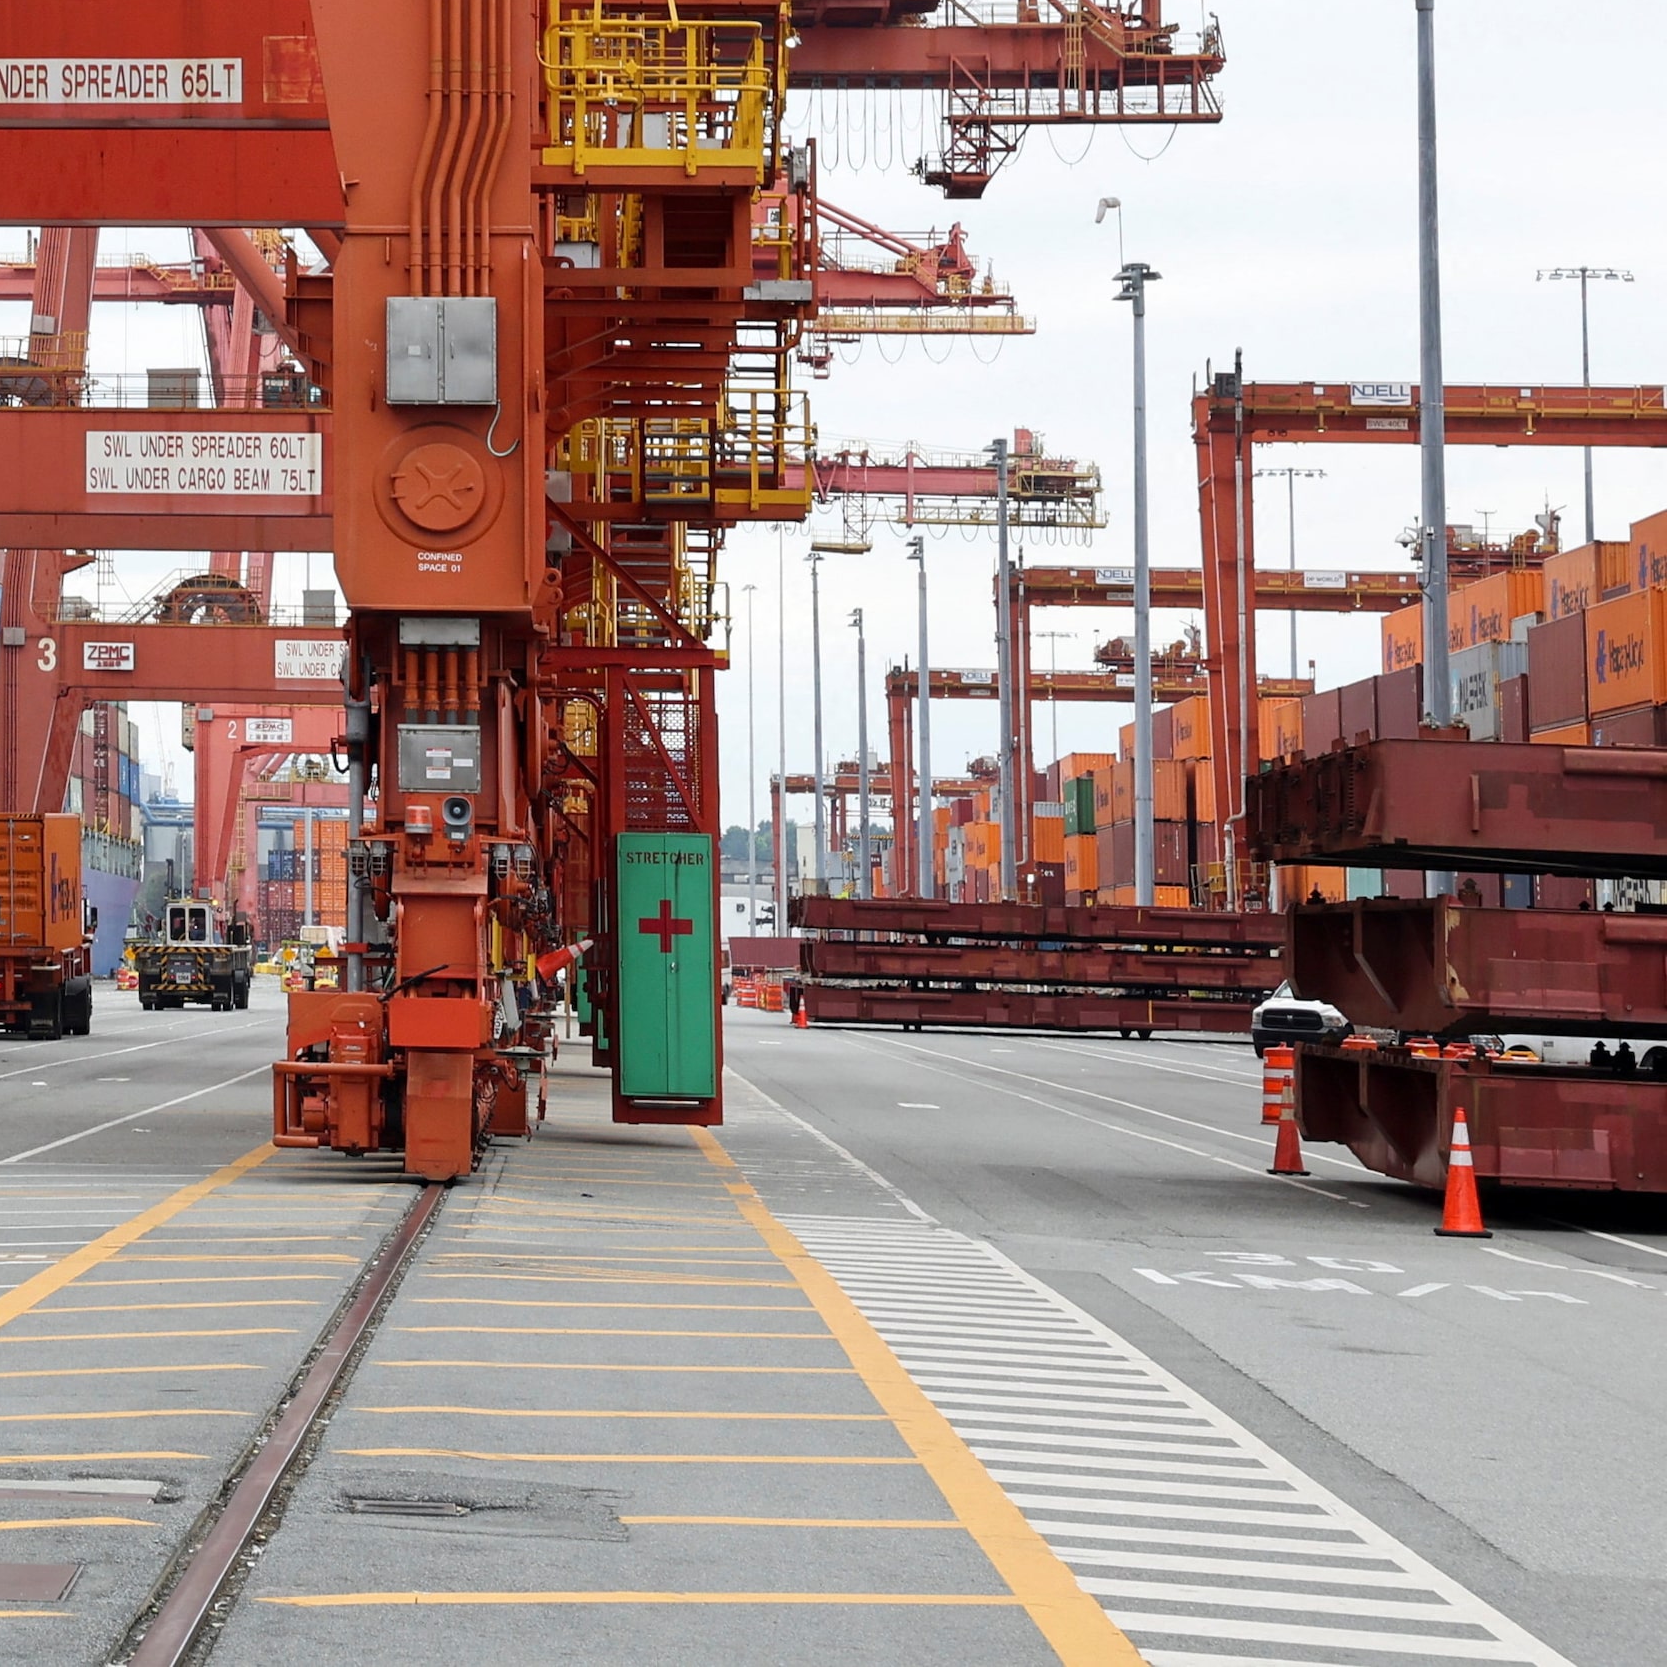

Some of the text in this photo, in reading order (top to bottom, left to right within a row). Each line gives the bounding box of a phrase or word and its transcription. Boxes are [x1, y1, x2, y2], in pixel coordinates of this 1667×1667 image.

[61, 64, 168, 98] SPREADER
[181, 64, 235, 98] 65LT
[1352, 385, 1411, 397] NOELL
[103, 436, 306, 459] SWL UNDER SPREADER 60LT
[89, 467, 316, 491] SWL UNDER CARGO BEAM 75LT
[417, 553, 463, 562] CONFINED
[418, 564, 447, 572] SPACE
[37, 637, 56, 672] 3
[87, 645, 130, 660] ZPMC
[286, 643, 335, 656] SWL UNDER
[277, 663, 326, 676] SWL UNDER
[228, 721, 238, 739] 2
[627, 852, 704, 865] STRETCHER
